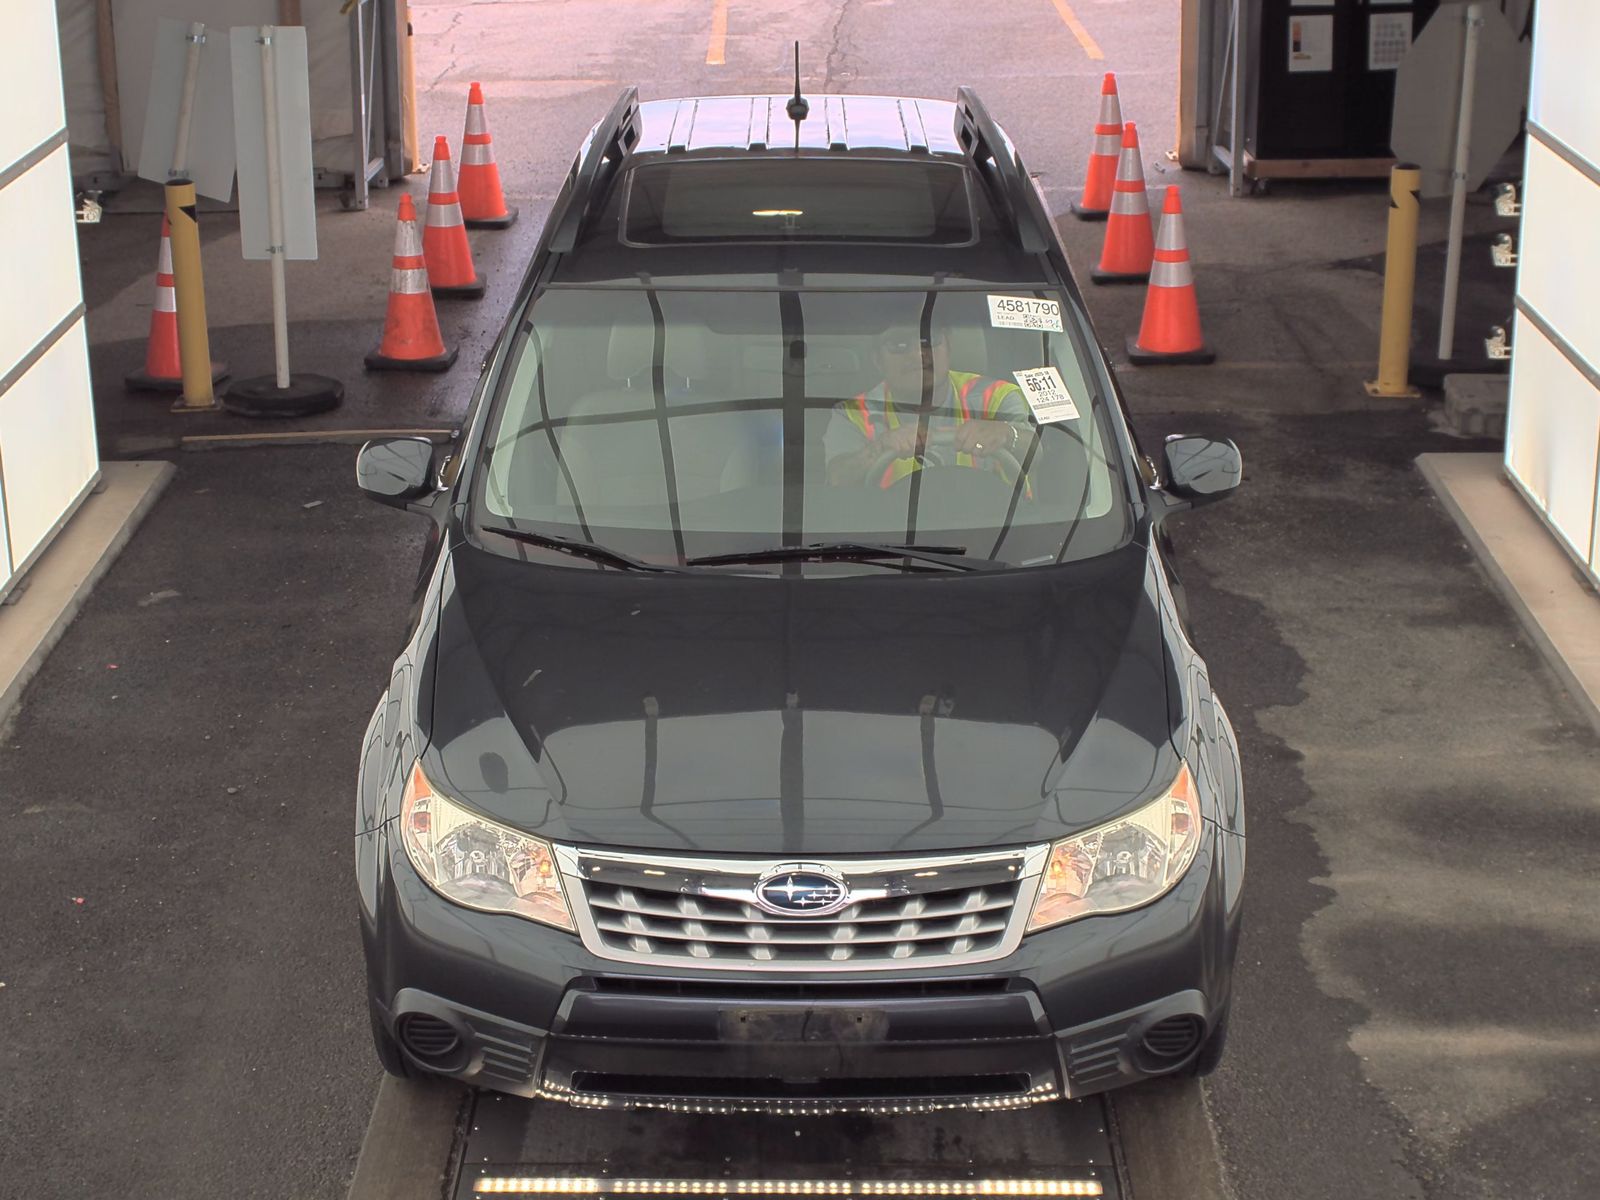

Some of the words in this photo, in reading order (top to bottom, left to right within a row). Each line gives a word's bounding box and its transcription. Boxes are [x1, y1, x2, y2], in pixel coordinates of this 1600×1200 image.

[997, 299, 1060, 316] 4581790
[1025, 375, 1057, 393] 56:11
[1037, 389, 1057, 398] 2012
